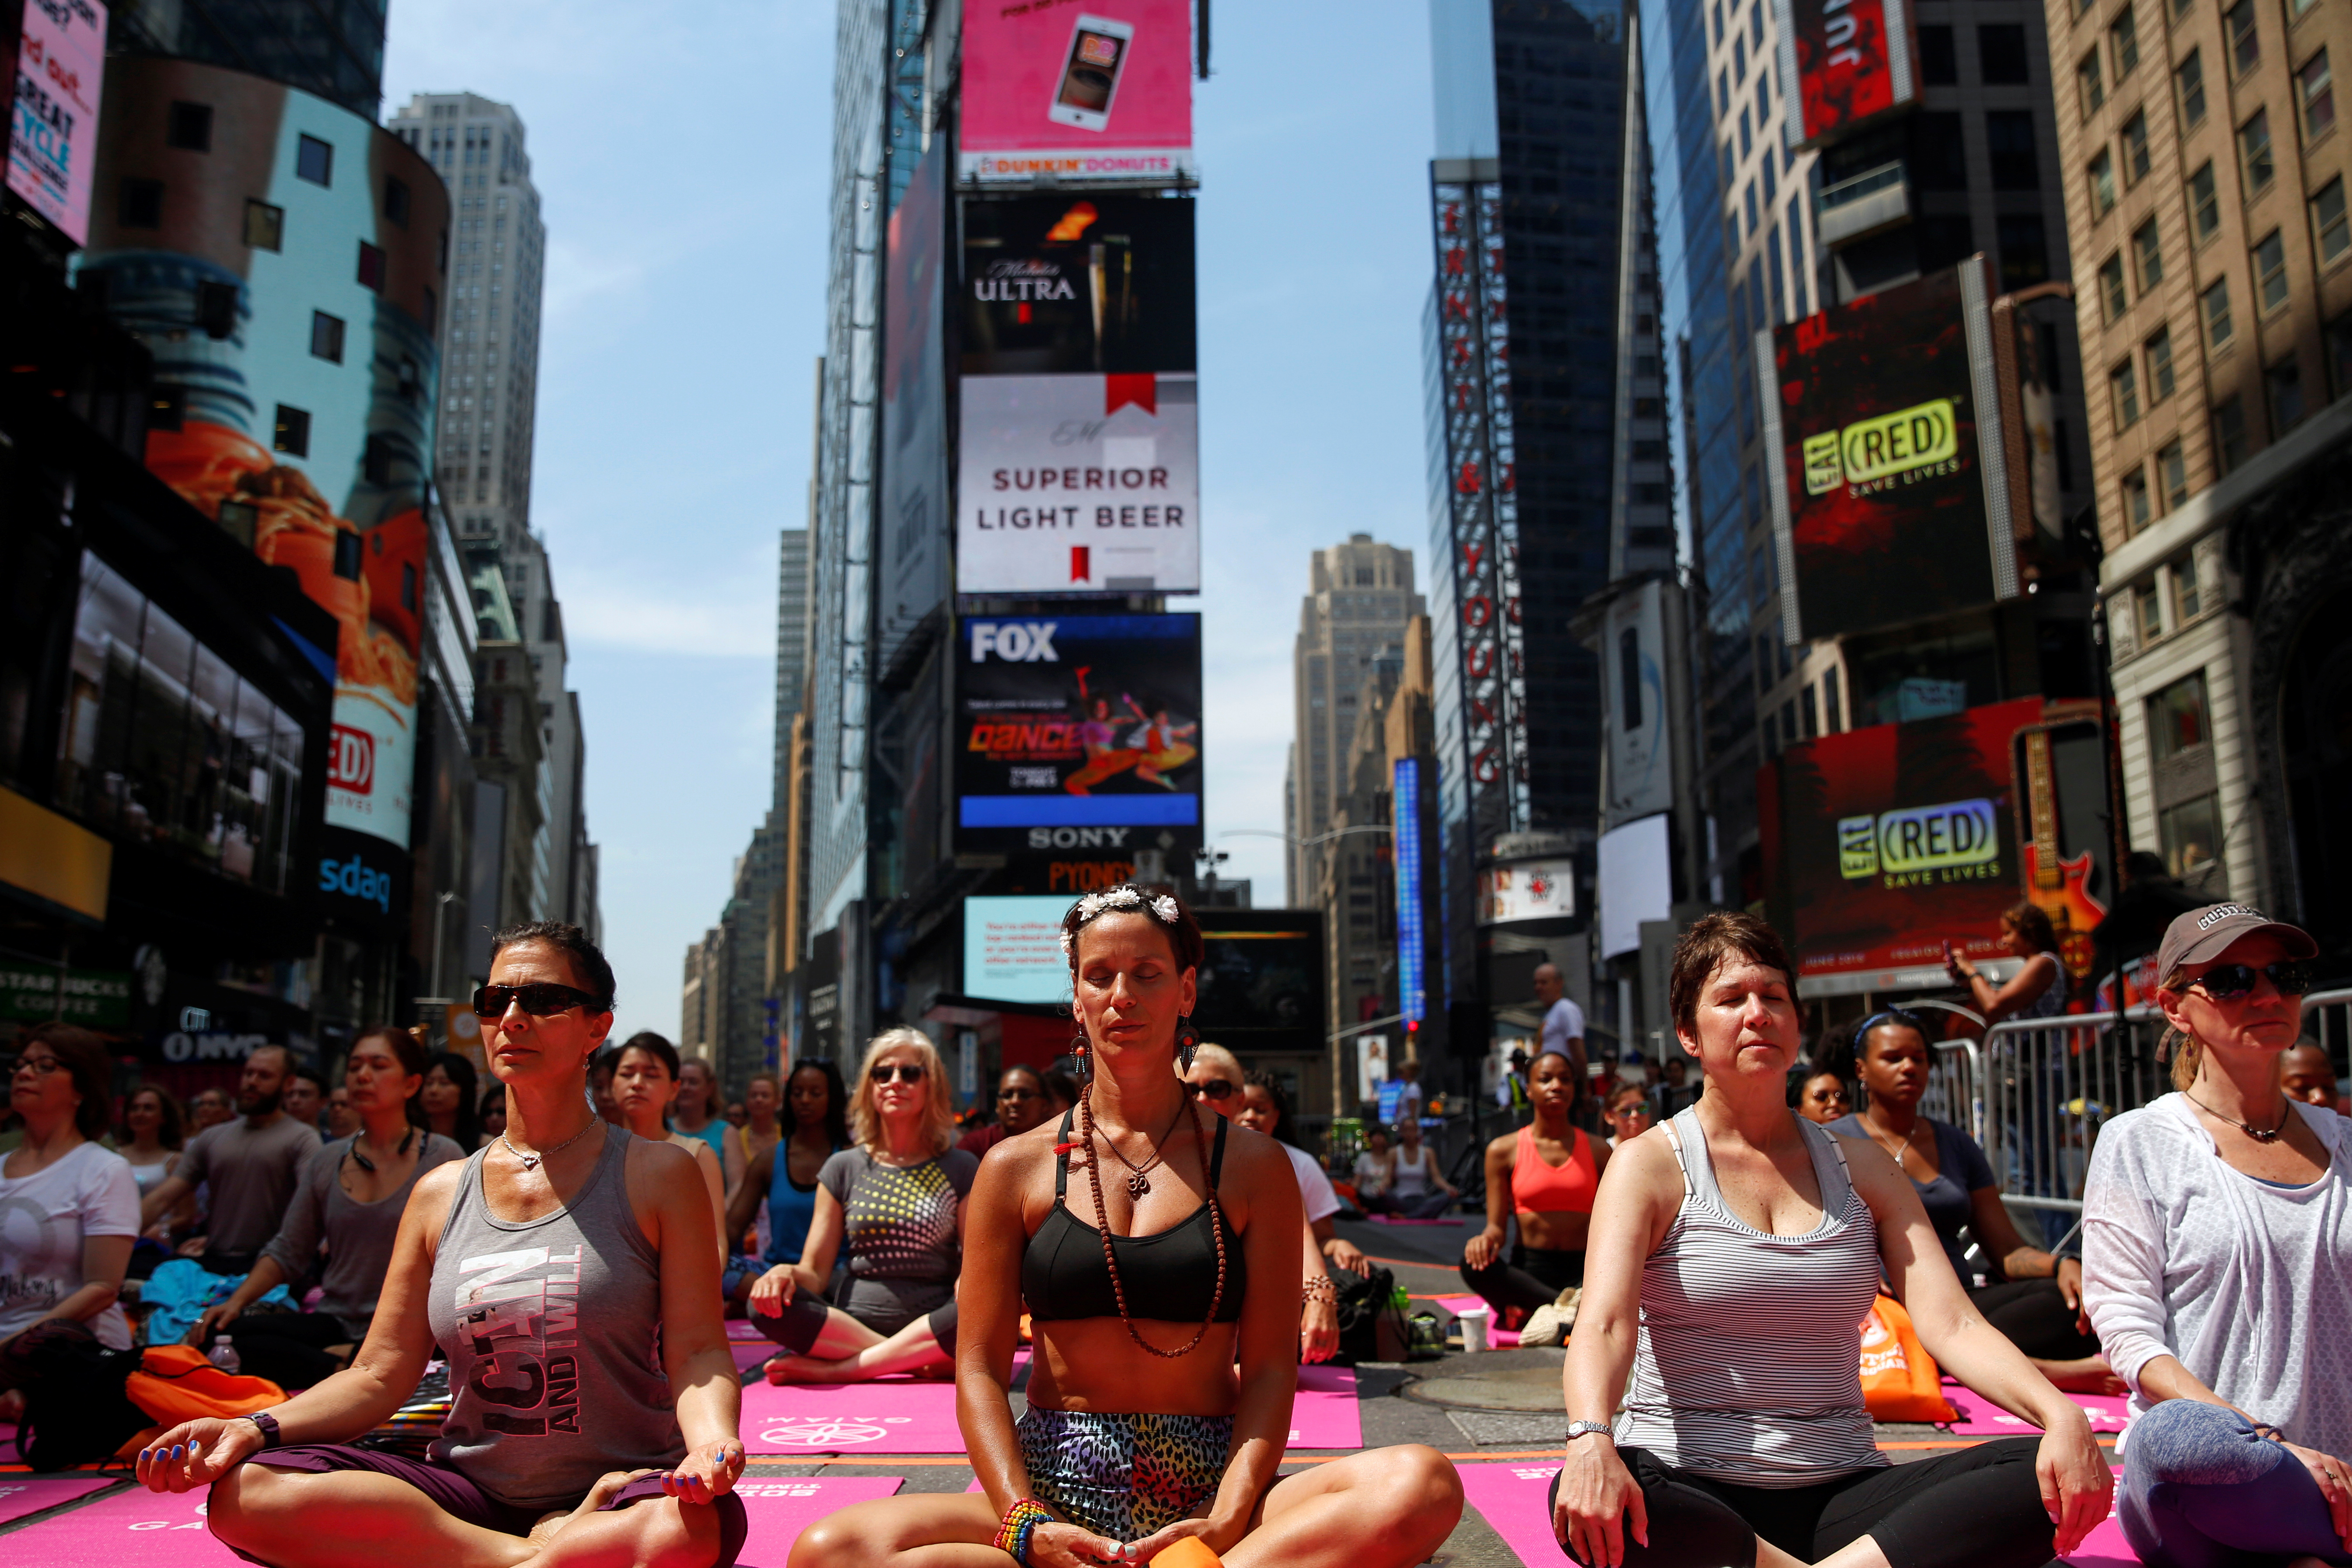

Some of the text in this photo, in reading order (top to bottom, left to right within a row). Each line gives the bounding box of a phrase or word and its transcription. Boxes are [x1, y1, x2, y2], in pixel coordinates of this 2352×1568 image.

[1085, 157, 1170, 172] DONUTS
[974, 278, 1077, 301] ULTRA
[1848, 410, 1946, 473] (RED)
[993, 467, 1169, 491] SUPERIOR
[1456, 461, 1482, 494] &
[1849, 456, 1960, 499] SAVE LIVES
[977, 505, 1184, 529] LIGHT BEER
[971, 623, 1060, 662] FOX
[1463, 542, 1500, 782] YOUNG
[1028, 829, 1131, 848] SONY
[1884, 809, 1986, 862] (RED)
[318, 854, 391, 914] sdaq
[1884, 861, 2001, 889] SAVE LIVES
[546, 1244, 582, 1335] WILL
[547, 1355, 581, 1434] AND
